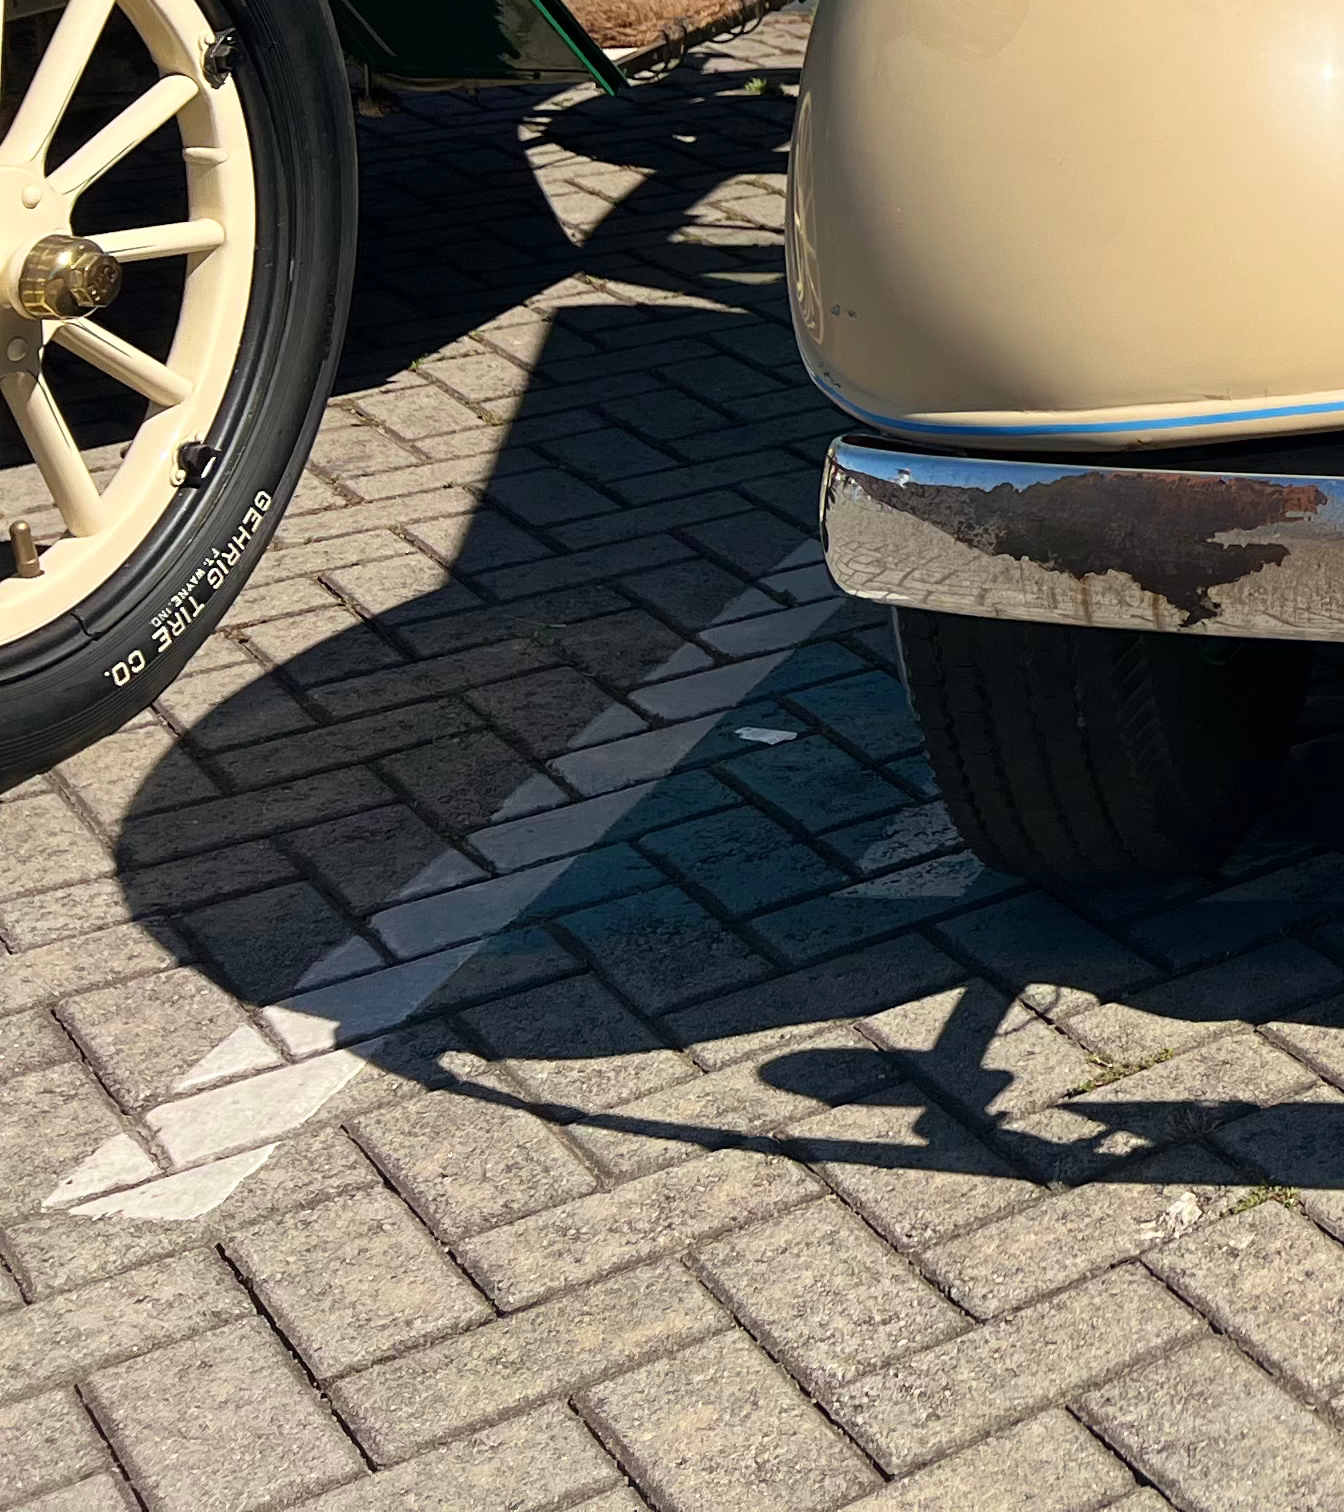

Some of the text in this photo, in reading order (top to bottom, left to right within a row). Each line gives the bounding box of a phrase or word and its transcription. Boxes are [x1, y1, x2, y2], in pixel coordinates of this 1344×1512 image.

[104, 490, 272, 687] GEHRIG TIRE CO.
